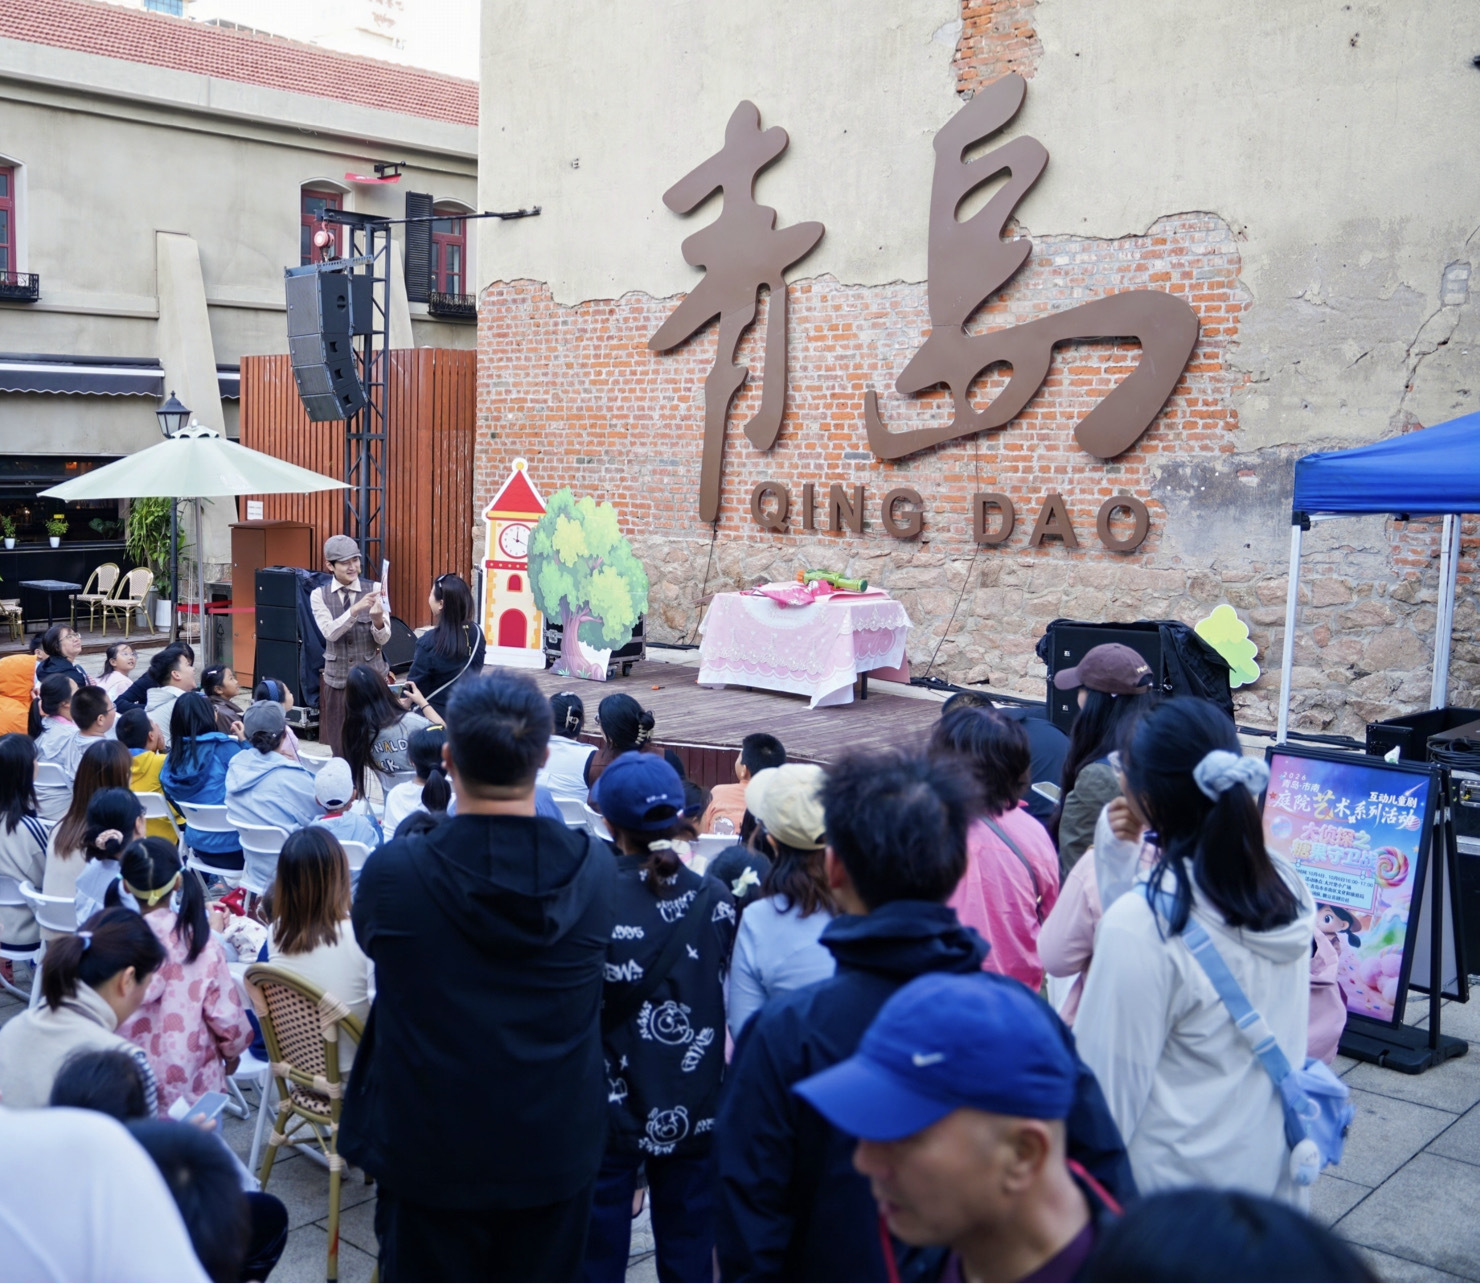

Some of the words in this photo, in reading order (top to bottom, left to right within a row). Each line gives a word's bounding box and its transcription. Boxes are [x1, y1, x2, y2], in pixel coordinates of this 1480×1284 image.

[750, 481, 925, 539] QING
[972, 492, 1151, 552] DAO
[371, 738, 409, 753] NALD
[1273, 789, 1415, 830] 庭院艺术系列活动
[1368, 791, 1418, 809] 互动儿童剧
